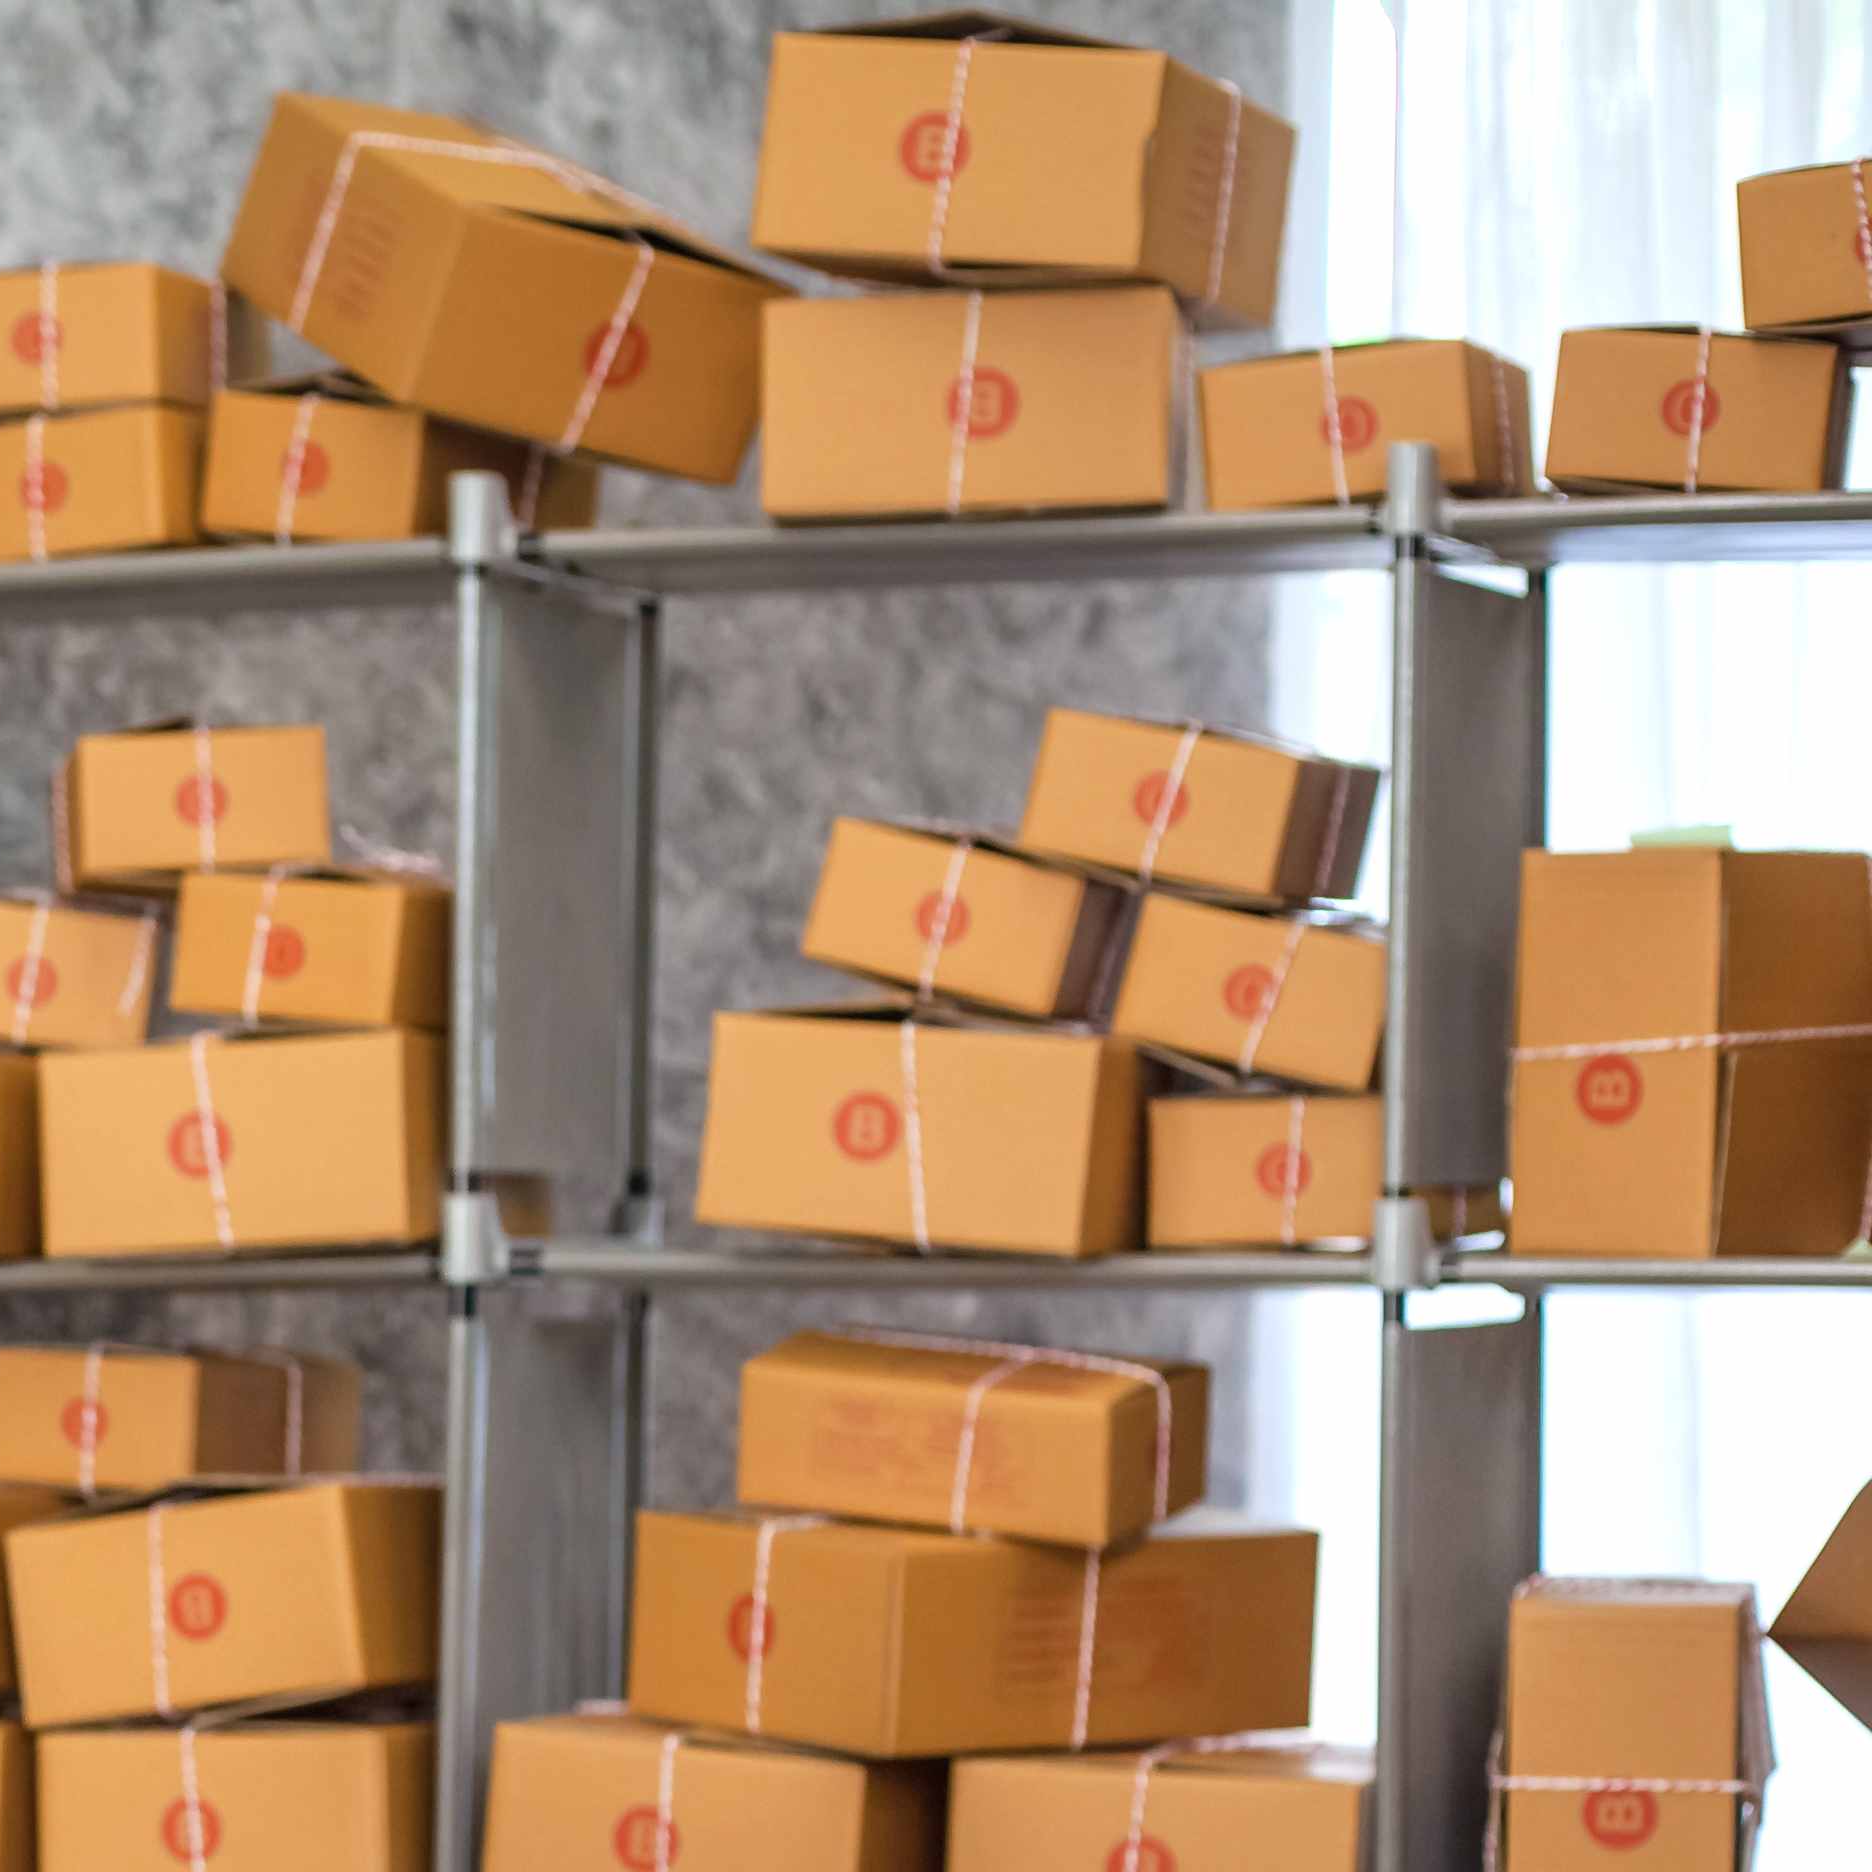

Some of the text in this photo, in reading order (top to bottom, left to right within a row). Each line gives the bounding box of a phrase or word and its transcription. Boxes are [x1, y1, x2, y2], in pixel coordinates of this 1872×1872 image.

[1589, 1069, 1630, 1108] B
[851, 1104, 886, 1149] B
[1596, 1795, 1645, 1833] B
